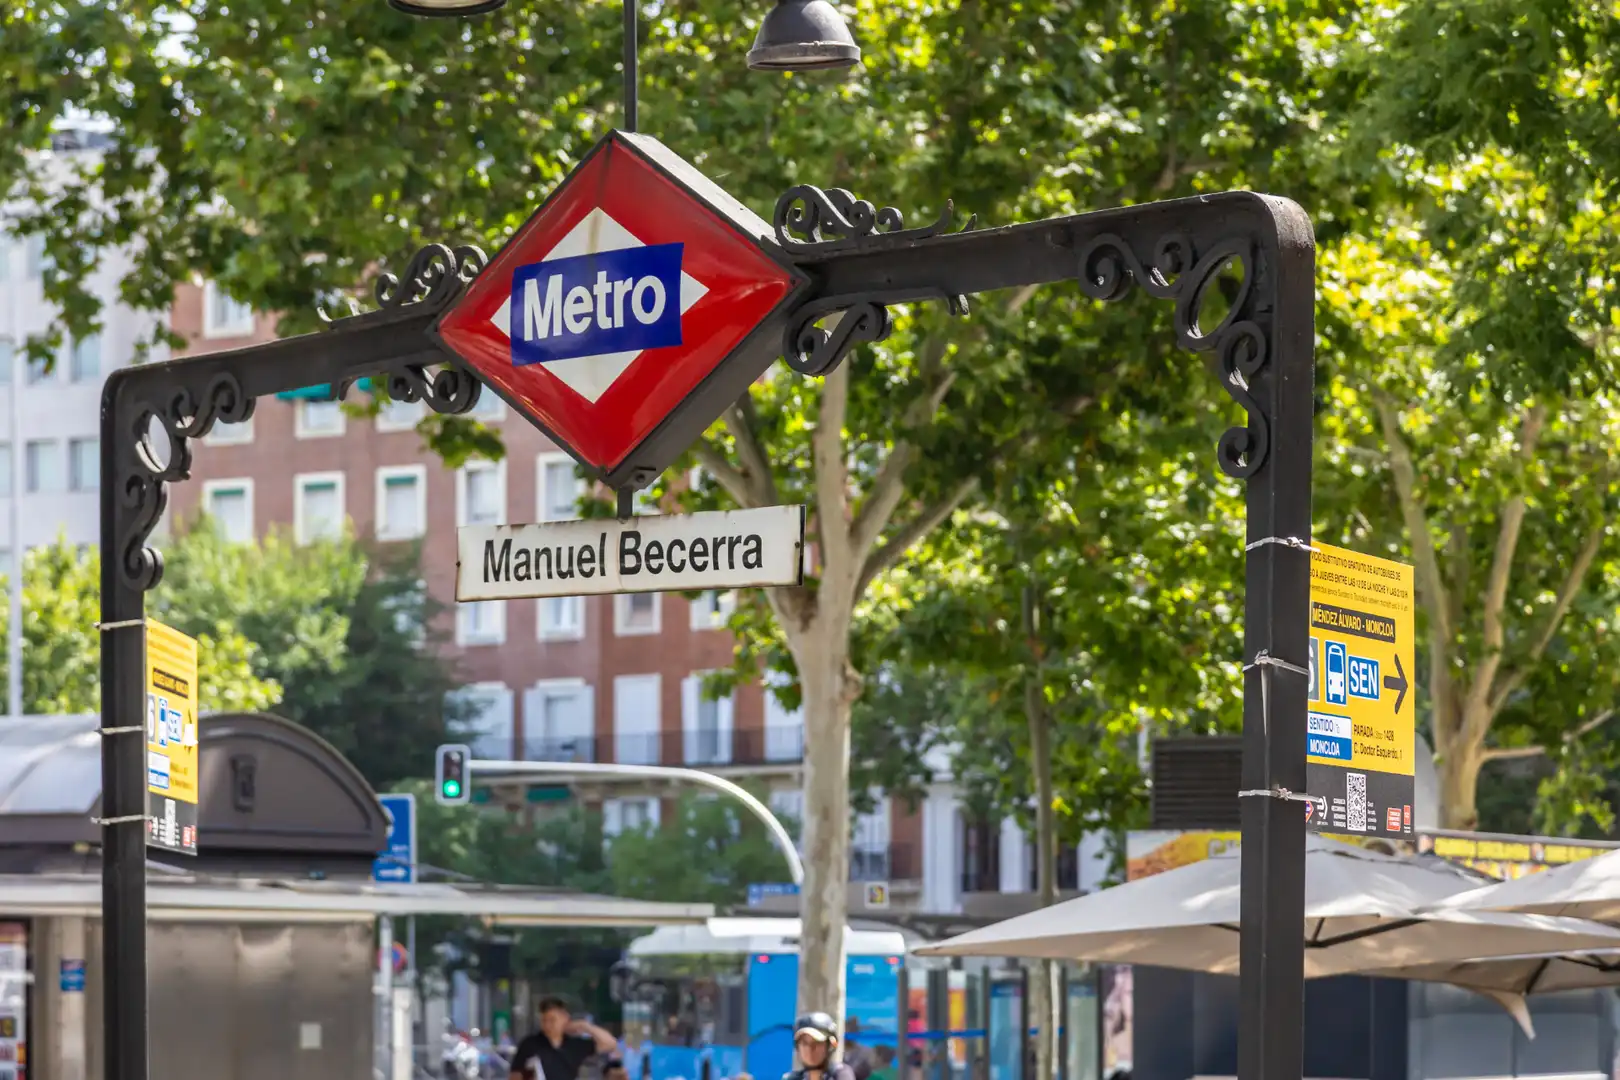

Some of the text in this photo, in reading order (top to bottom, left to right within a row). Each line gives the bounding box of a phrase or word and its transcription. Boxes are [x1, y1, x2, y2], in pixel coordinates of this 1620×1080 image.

[524, 270, 666, 342] Metro
[483, 530, 763, 583] Manuel Becerra
[1312, 605, 1338, 626] MÉNDEZ
[1338, 609, 1361, 631] ÁLVARO
[1365, 619, 1395, 637] MONCLOA
[1350, 660, 1378, 696] SEN
[1309, 716, 1334, 732] SENTIDO
[1353, 723, 1374, 738] PARADA
[1309, 738, 1340, 756] MONCLOA
